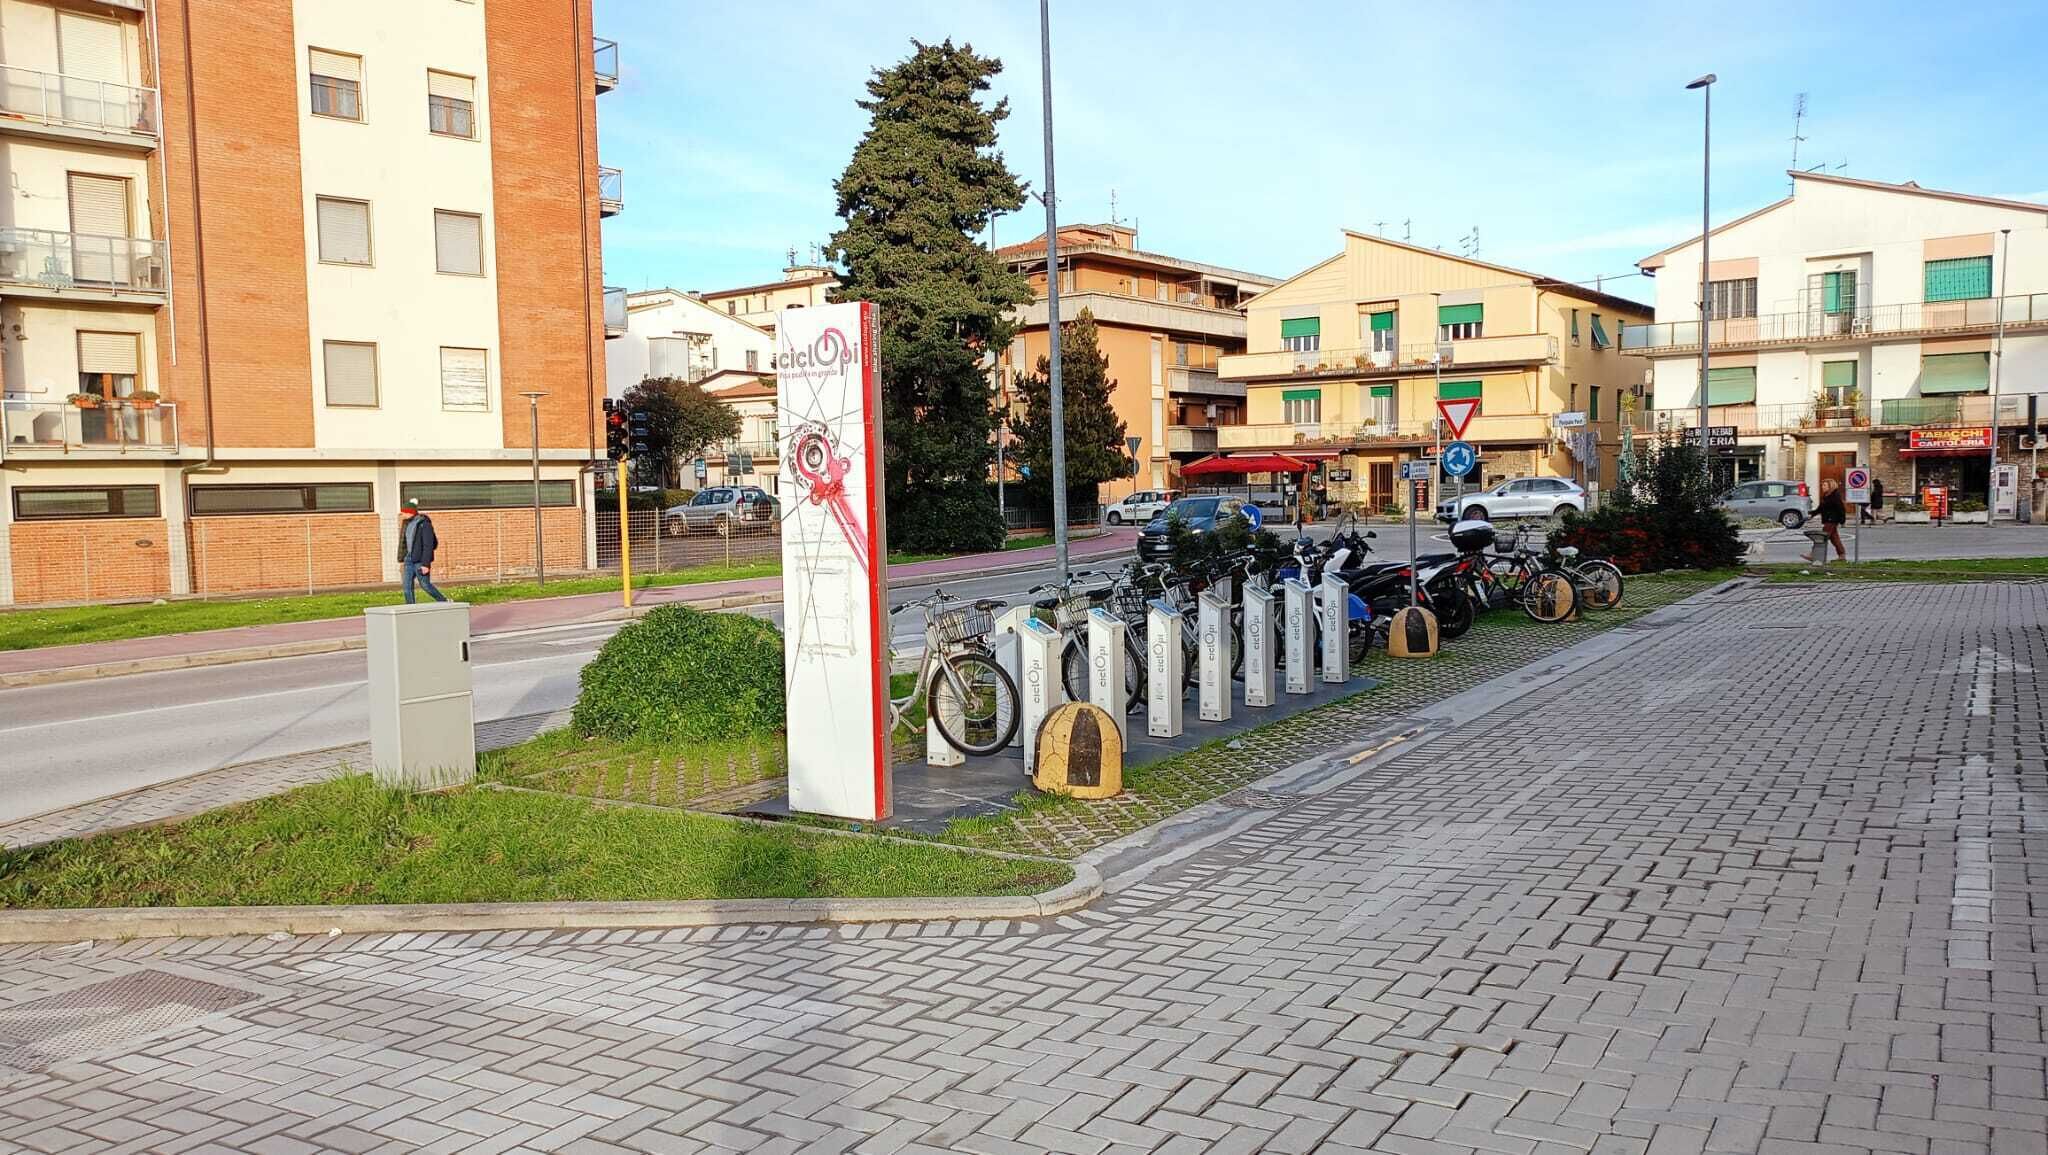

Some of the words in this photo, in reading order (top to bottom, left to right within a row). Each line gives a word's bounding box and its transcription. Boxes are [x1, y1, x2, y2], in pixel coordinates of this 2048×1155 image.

[1711, 427, 1734, 436] KEBAB
[1919, 428, 1984, 438] TABACCHI
[1685, 436, 1736, 447] PIZERIA
[1918, 439, 1985, 447] CARTOLERIA
[1402, 464, 1409, 477] P
